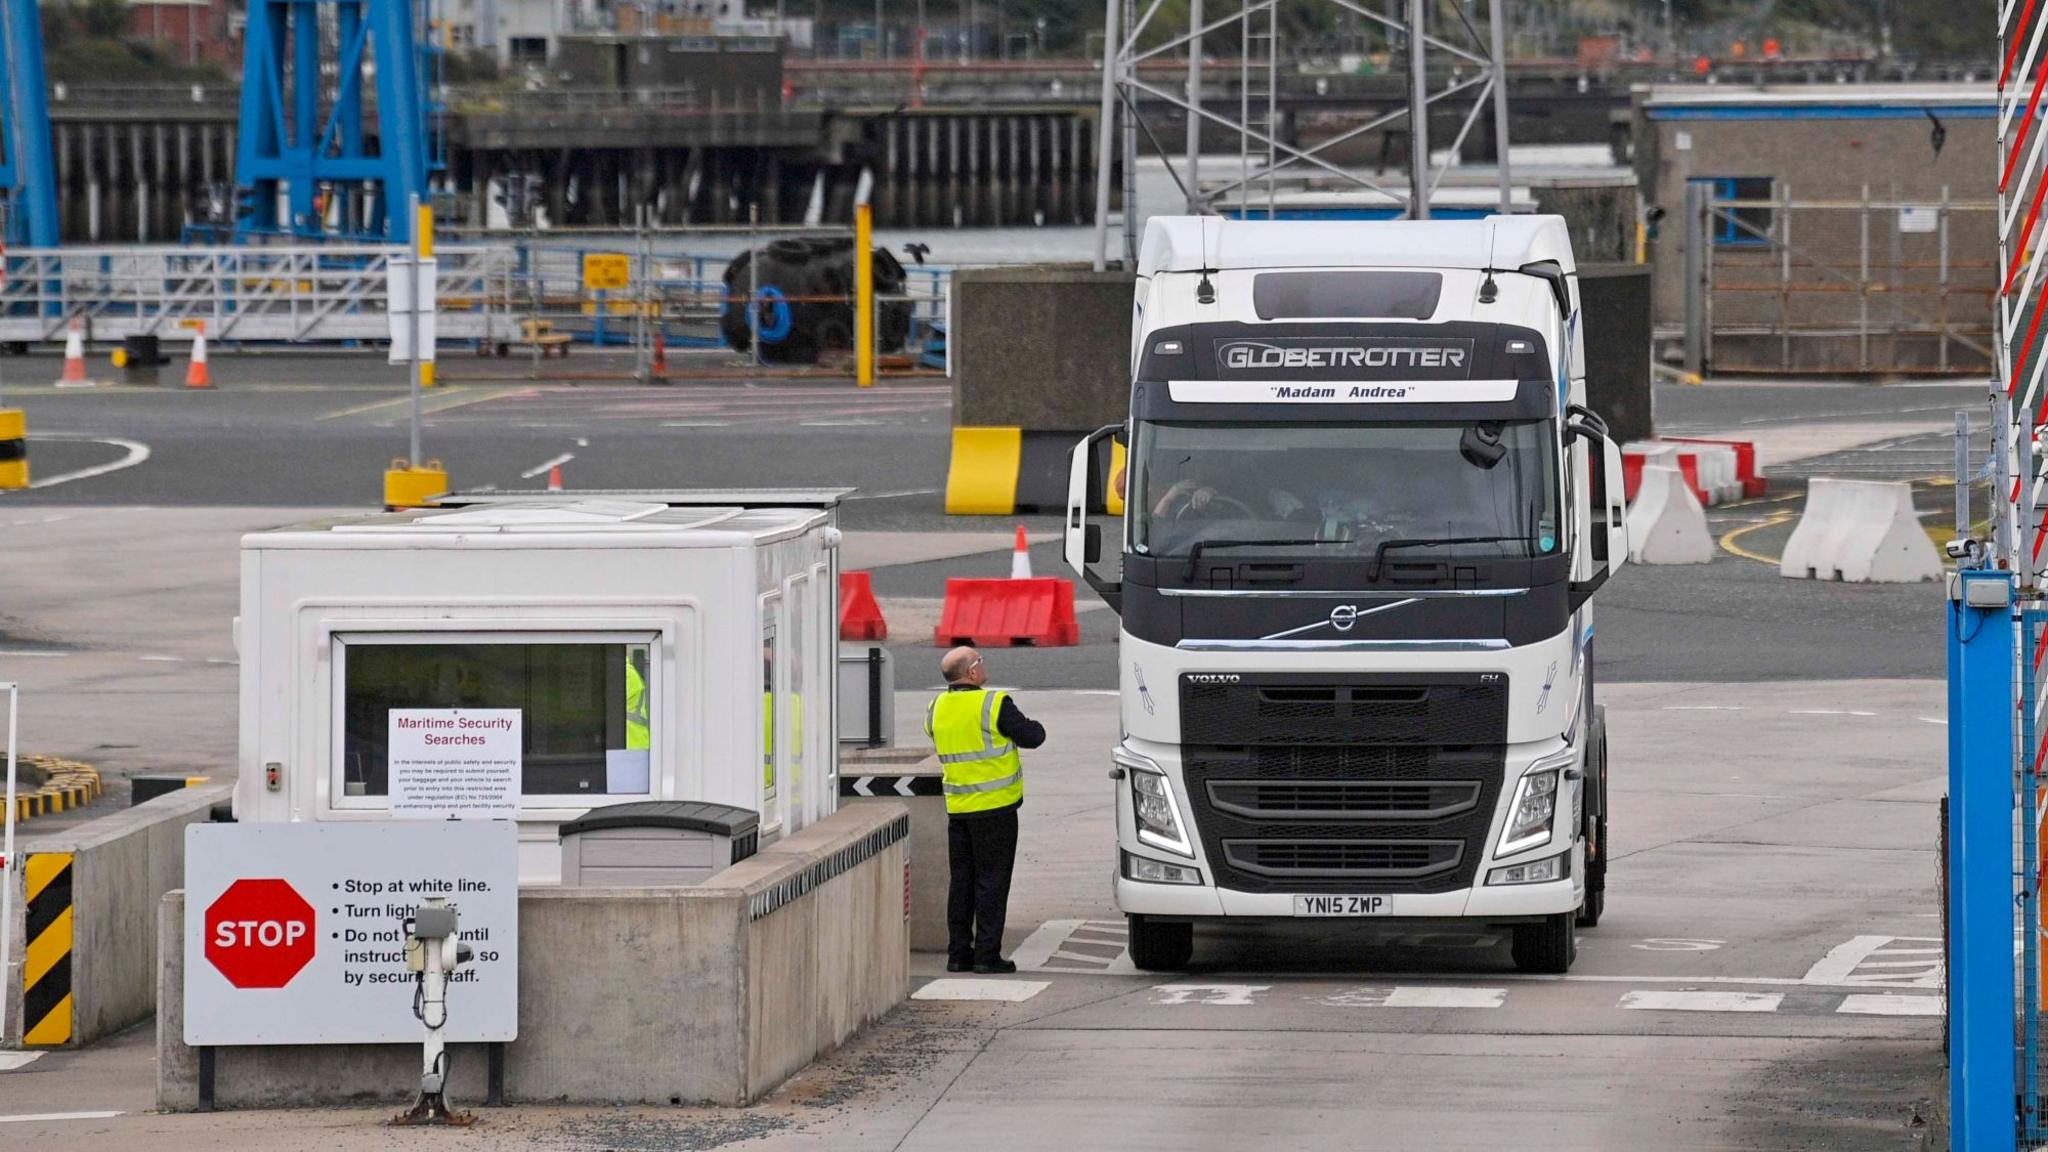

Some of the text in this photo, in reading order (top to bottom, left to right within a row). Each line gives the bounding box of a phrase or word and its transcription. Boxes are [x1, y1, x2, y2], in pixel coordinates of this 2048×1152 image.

[1227, 346, 1465, 369] GLOBETROTTER
[1270, 386, 1416, 399] "Madam Andrea"
[1187, 674, 1241, 684] VOLVO
[1480, 674, 1499, 682] FH
[397, 718, 513, 732] Maritime Security
[424, 734, 486, 746] Searches
[344, 878, 492, 895] Stop at white line.
[344, 904, 381, 918] Turn
[1304, 897, 1383, 913] YN15 ZWP
[214, 920, 306, 948] STOP
[344, 929, 367, 942] Do
[373, 929, 399, 942] not
[480, 951, 499, 962] so
[344, 971, 364, 986] by
